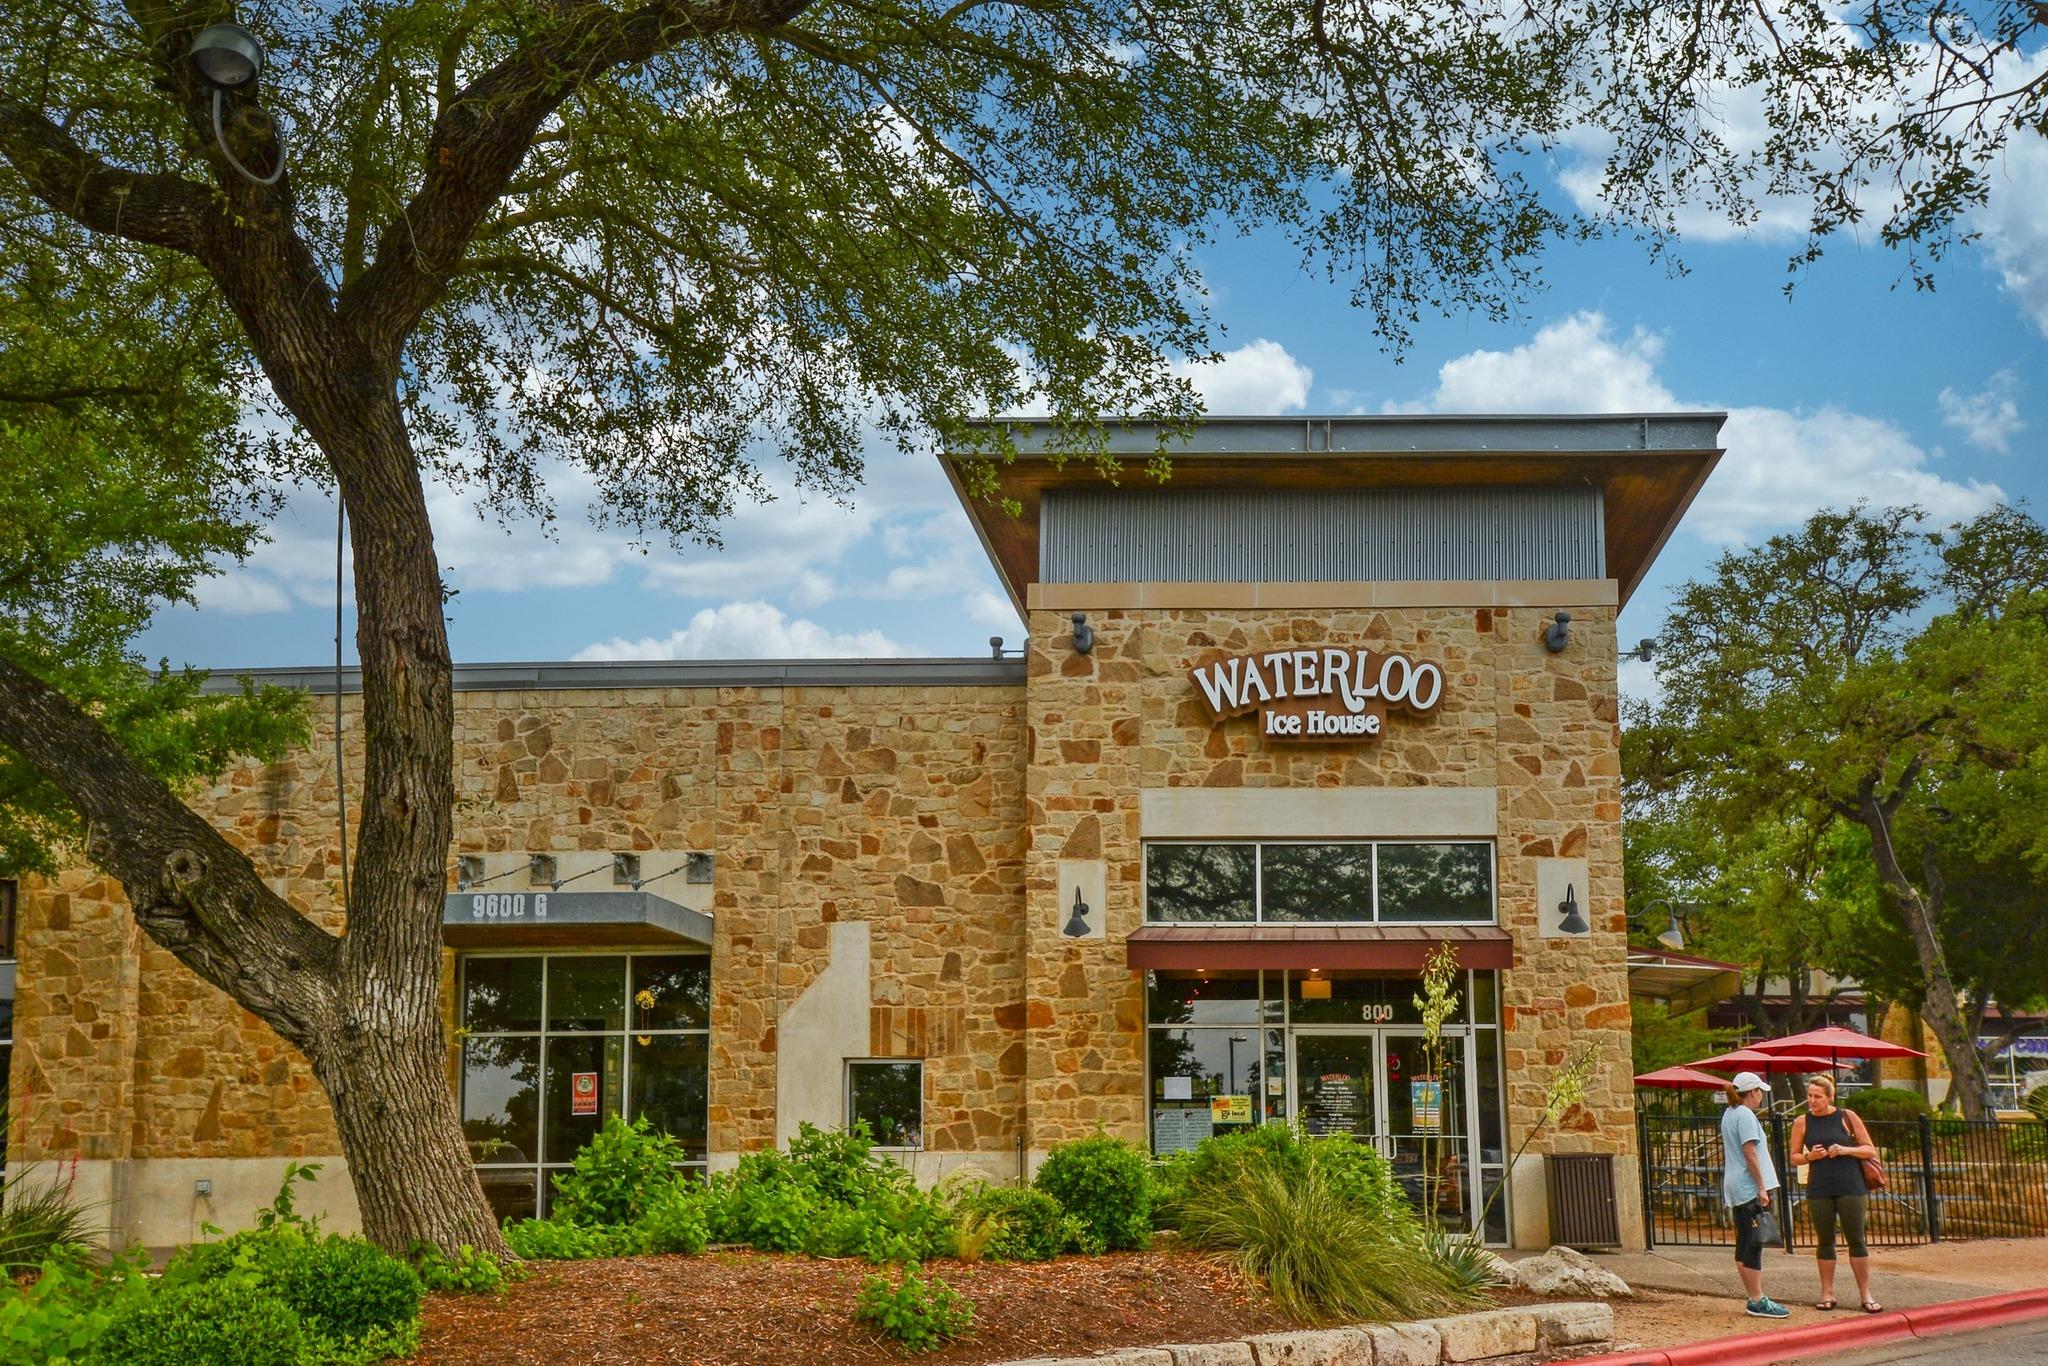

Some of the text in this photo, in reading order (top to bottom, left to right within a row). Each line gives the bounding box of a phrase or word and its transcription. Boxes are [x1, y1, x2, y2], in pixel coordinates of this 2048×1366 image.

[1193, 649, 1442, 713] WATERLOO
[1265, 711, 1380, 735] Ice House
[473, 894, 547, 917] 9600 G
[1362, 1004, 1393, 1020] 800
